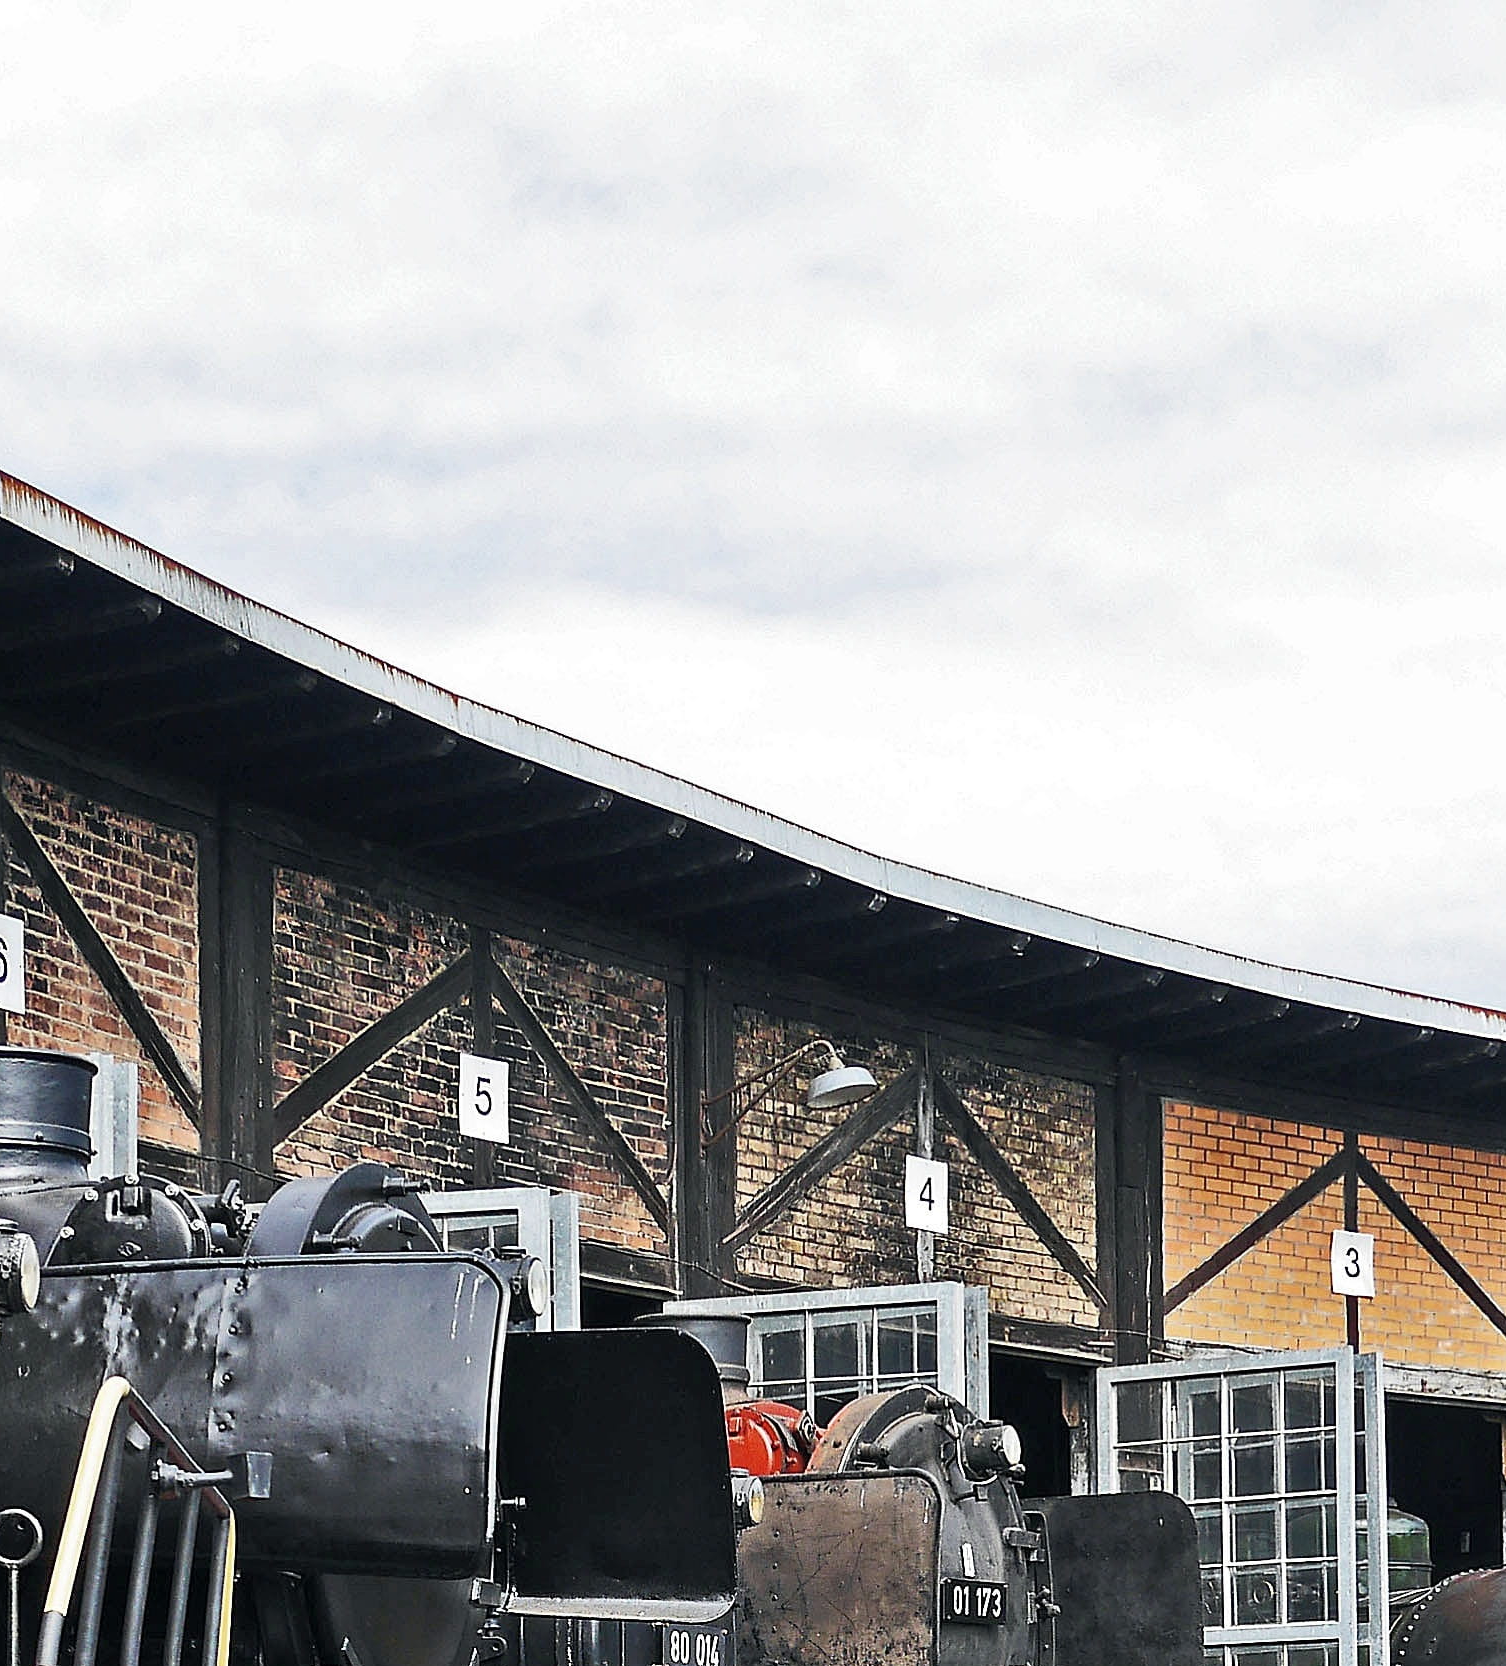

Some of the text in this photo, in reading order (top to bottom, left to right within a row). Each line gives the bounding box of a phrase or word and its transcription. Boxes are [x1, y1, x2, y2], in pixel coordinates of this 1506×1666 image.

[474, 1076, 492, 1116] 5
[919, 1177, 935, 1211] 4
[1344, 1247, 1361, 1278] 3
[953, 1585, 1002, 1618] 01 173
[670, 1630, 691, 1665] 80
